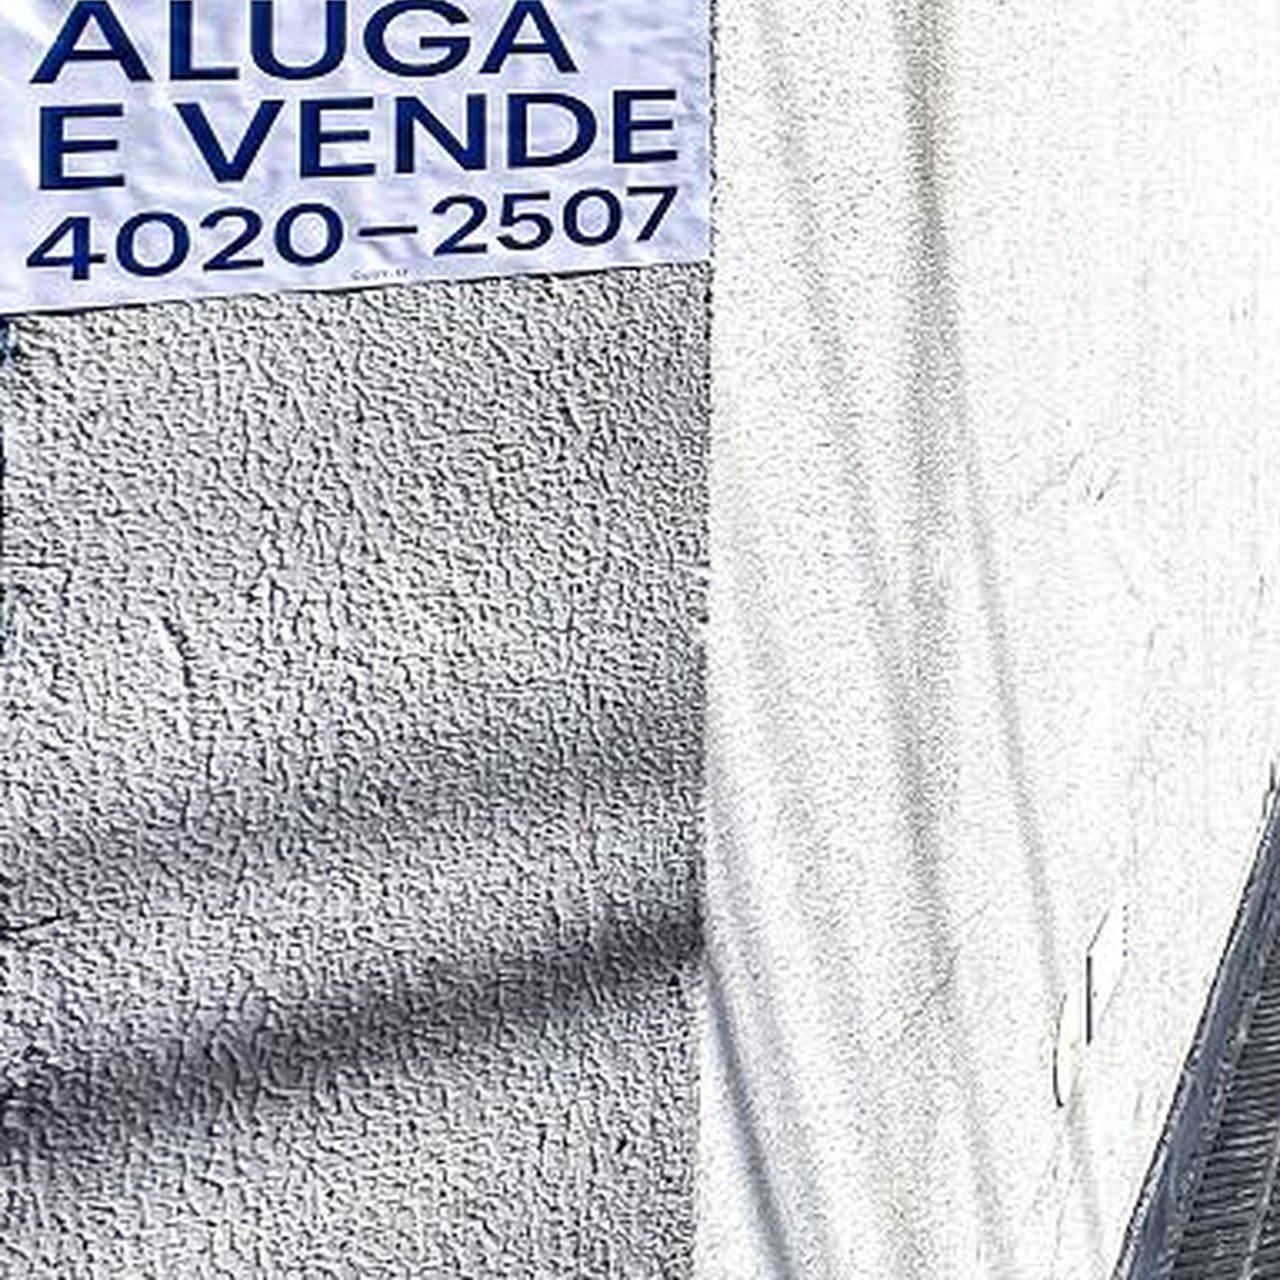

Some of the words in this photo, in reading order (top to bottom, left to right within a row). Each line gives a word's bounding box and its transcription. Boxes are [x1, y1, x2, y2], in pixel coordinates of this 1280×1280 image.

[37, 102, 127, 191] E
[172, 88, 680, 183] VENDE
[26, 185, 679, 282] 4020-2507
